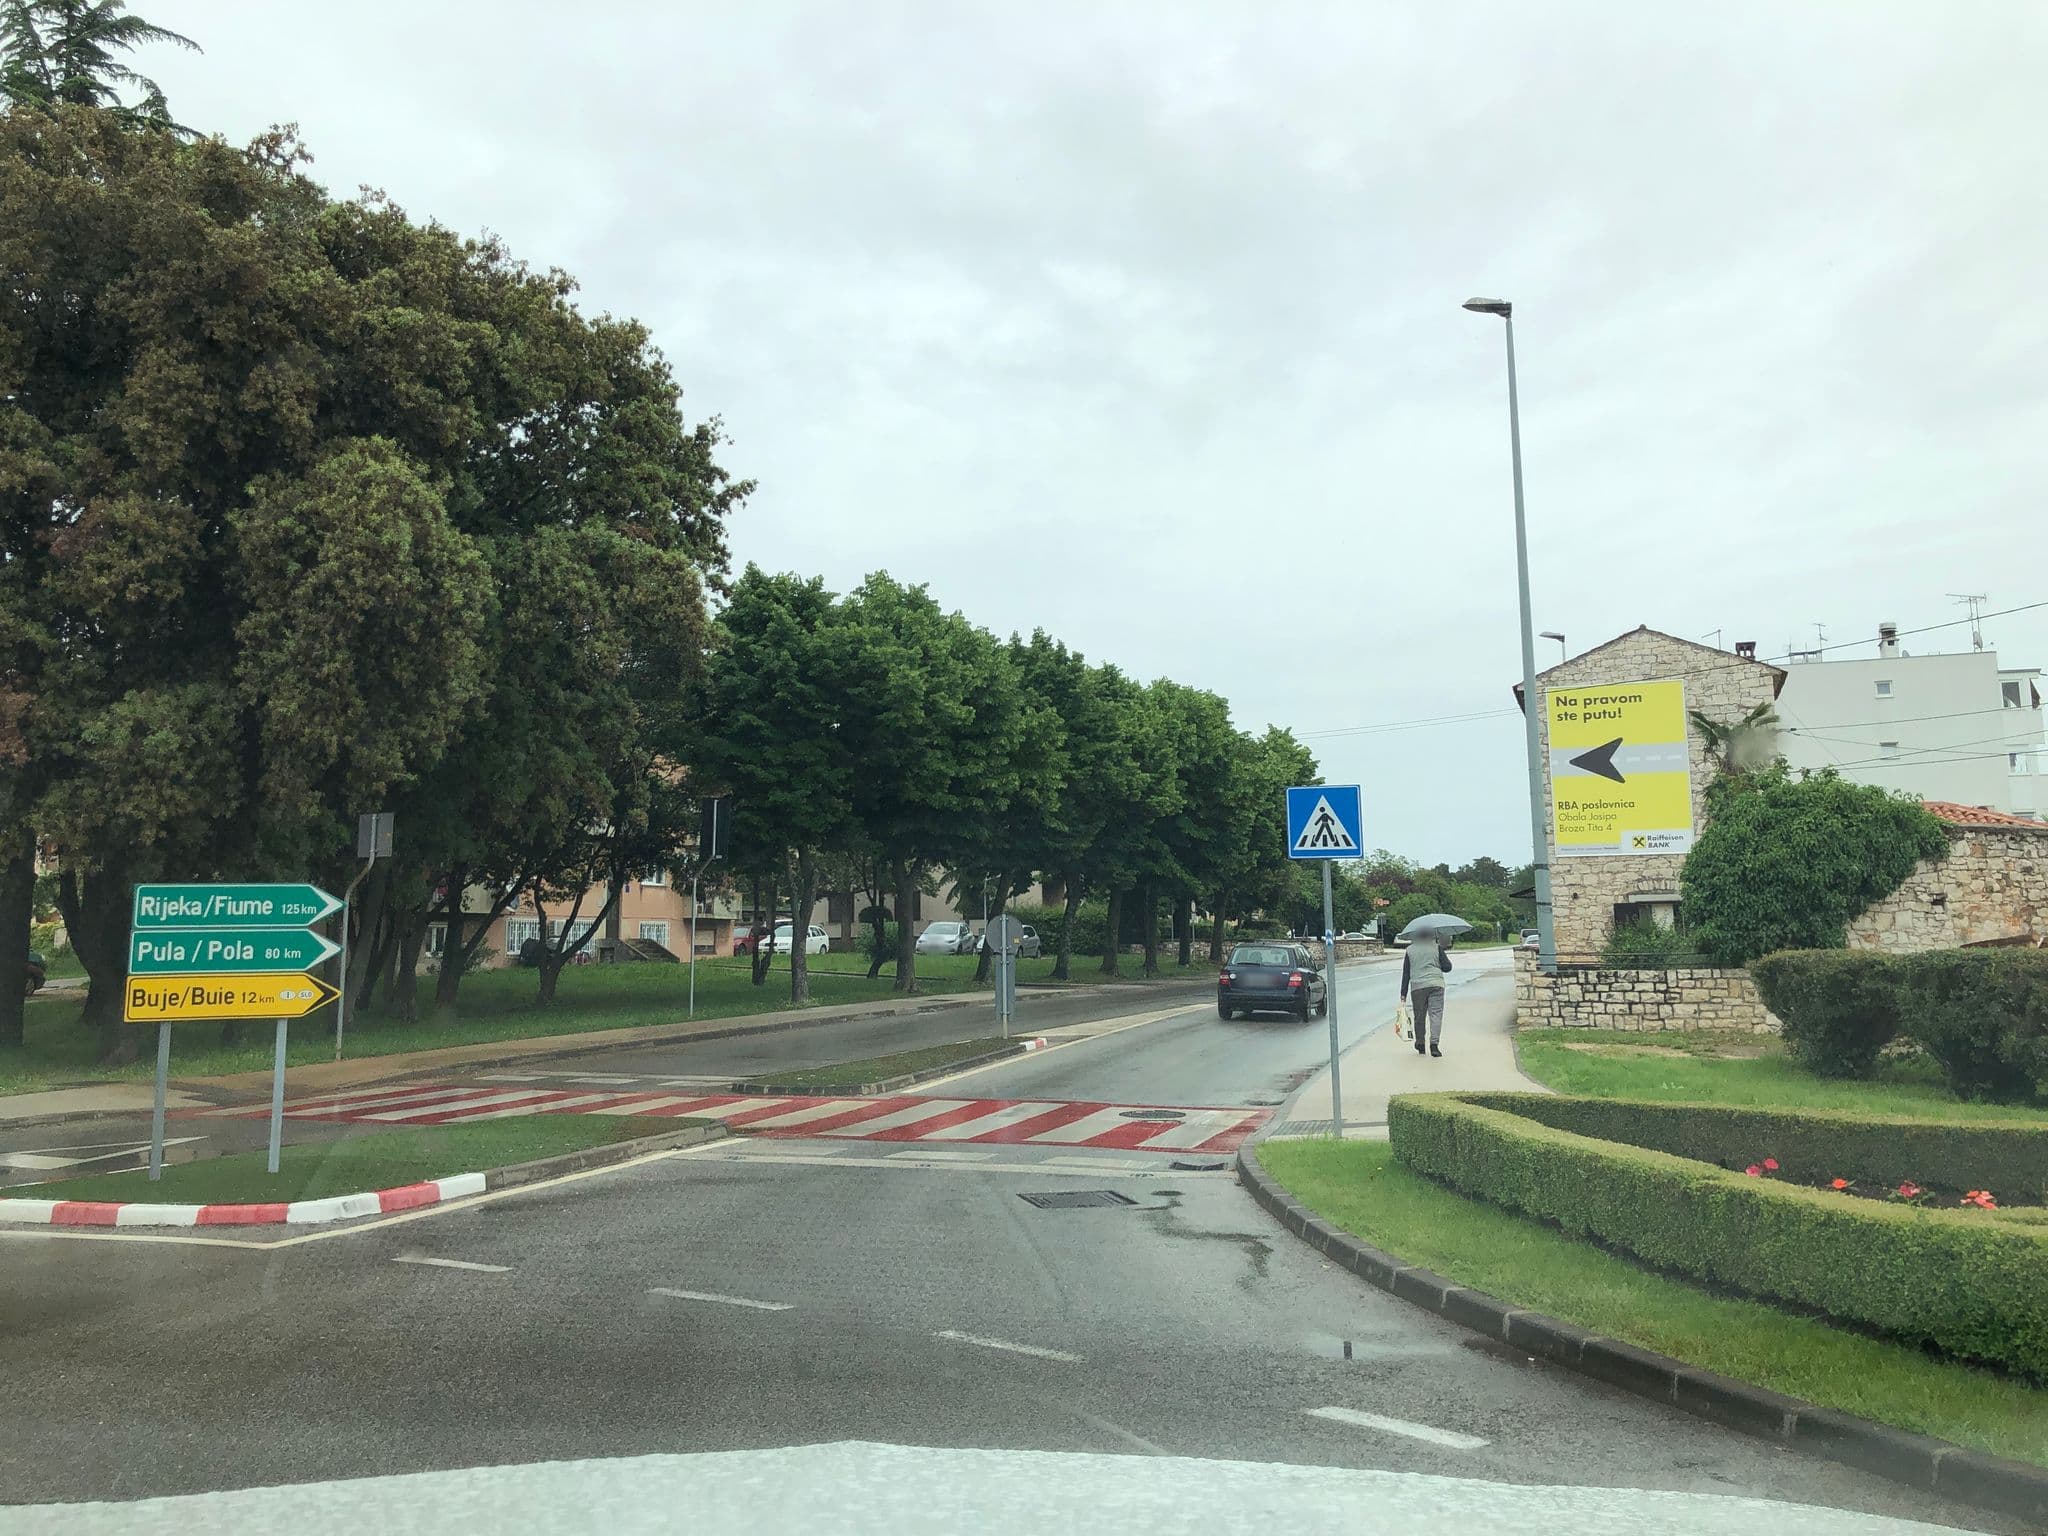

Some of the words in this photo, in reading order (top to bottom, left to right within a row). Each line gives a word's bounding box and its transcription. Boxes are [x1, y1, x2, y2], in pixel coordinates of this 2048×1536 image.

[1555, 696, 1578, 707] Na
[1583, 694, 1642, 709] pravom
[1556, 711, 1578, 722] ste
[1583, 707, 1622, 724] putu!
[1557, 801, 1579, 810] RBA
[1582, 799, 1635, 812] poslovnica
[1558, 811, 1587, 822] Obala
[1590, 812, 1617, 822] Josipa
[1587, 823, 1604, 832] Tita
[1606, 823, 1613, 831] 4
[141, 895, 273, 921] Rijeka/Fiume
[281, 903, 300, 915] 125
[301, 903, 317, 914] km
[137, 941, 186, 962] Pula
[207, 940, 254, 960] Pola
[265, 948, 280, 959] 80
[284, 948, 301, 959] km
[132, 986, 235, 1012] Buje/Buie
[242, 992, 257, 1004] 12
[259, 995, 275, 1004] km
